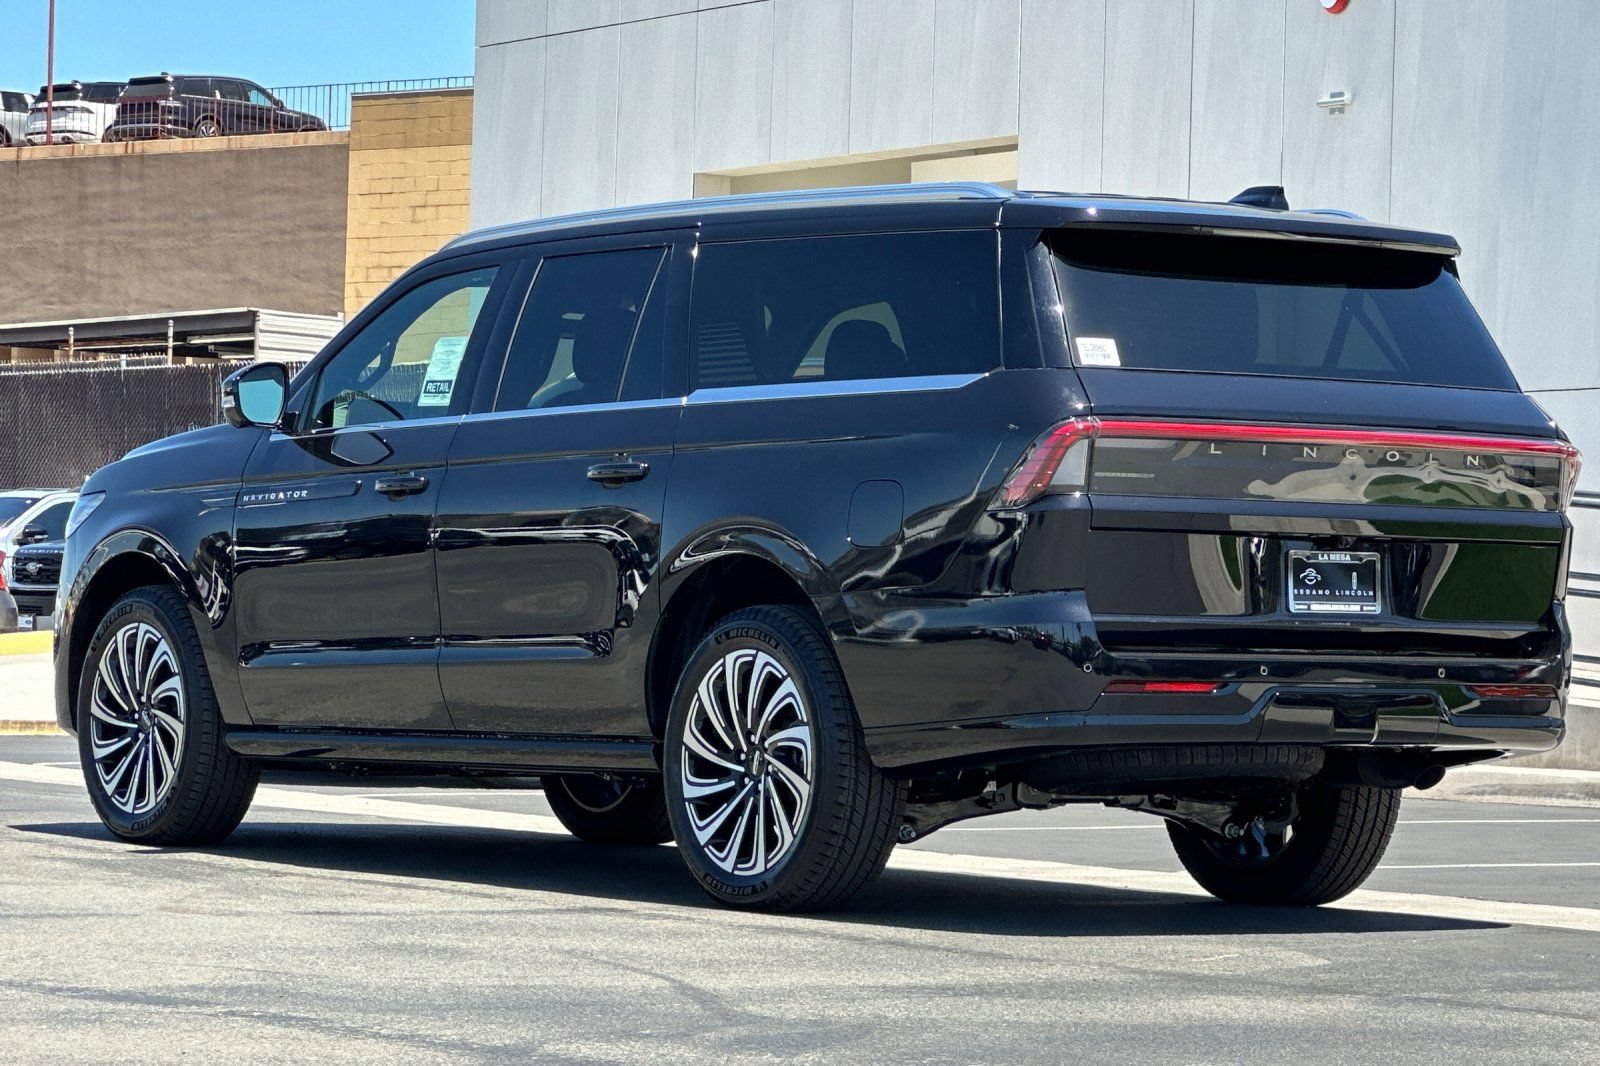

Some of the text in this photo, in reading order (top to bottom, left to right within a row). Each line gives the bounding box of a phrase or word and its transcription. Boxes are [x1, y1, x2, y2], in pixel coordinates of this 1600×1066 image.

[426, 382, 449, 392] RETAIL
[1209, 442, 1480, 466] LINCOLN
[243, 490, 308, 502] NAVIGATOR
[1318, 553, 1351, 561] LA MESA
[1294, 588, 1374, 597] SEDANO LINCOLN
[729, 627, 779, 649] MICHELIN
